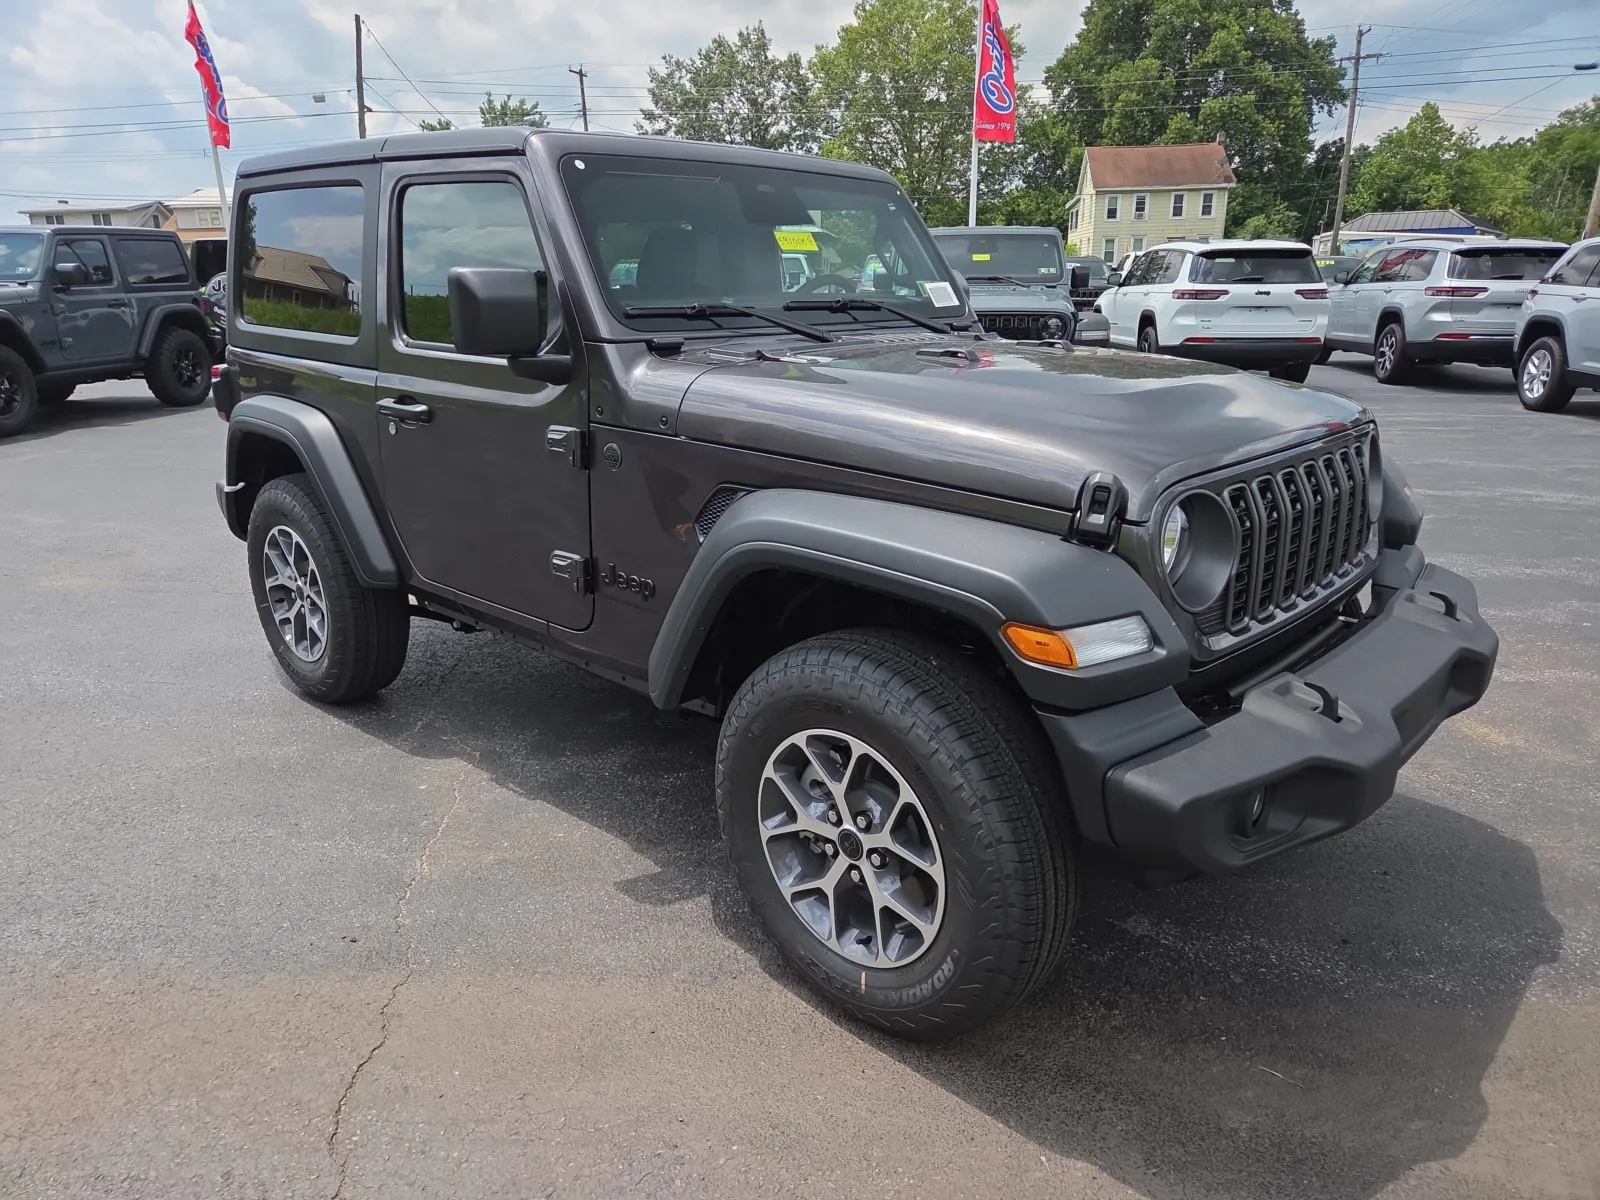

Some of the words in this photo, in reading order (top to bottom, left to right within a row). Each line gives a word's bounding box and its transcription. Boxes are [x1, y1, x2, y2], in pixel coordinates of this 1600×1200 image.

[977, 121, 995, 130] Since
[211, 279, 226, 294] Je
[601, 562, 656, 601] Jeep
